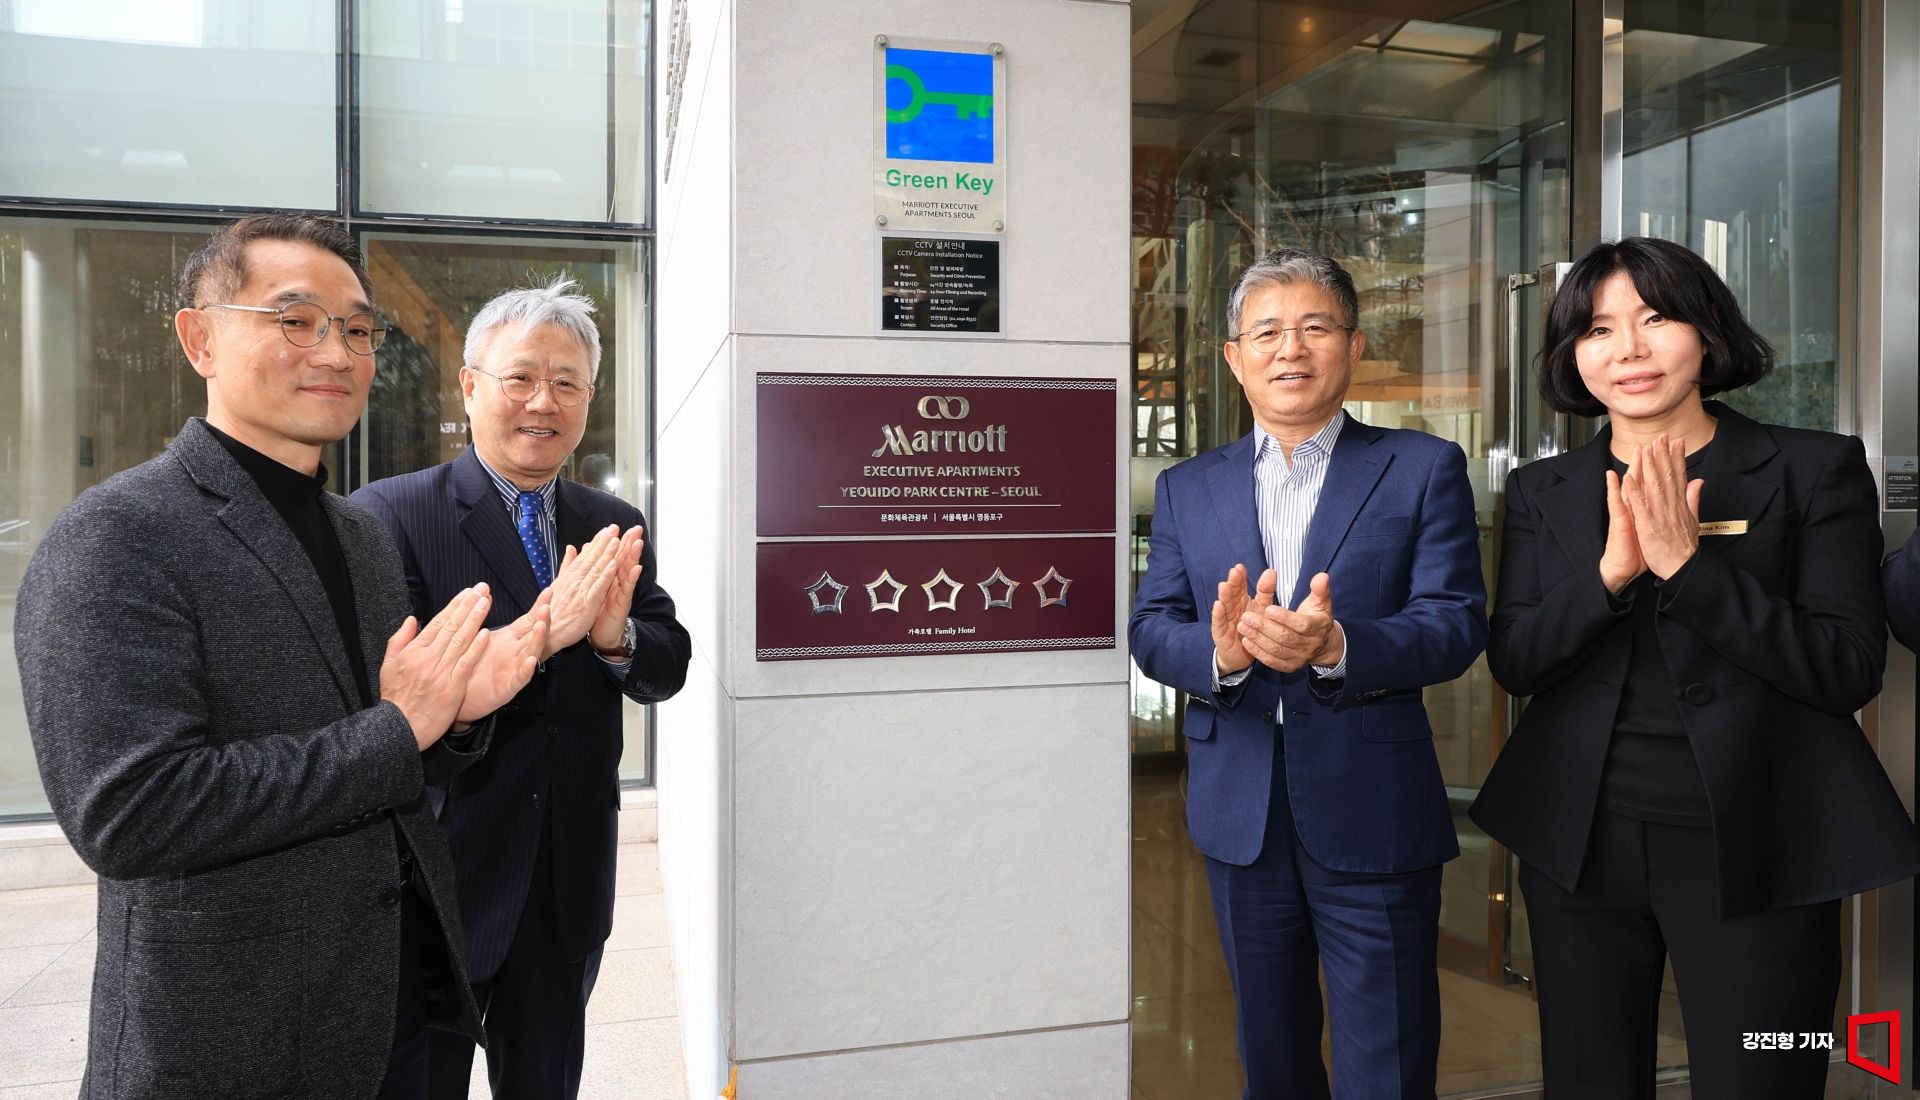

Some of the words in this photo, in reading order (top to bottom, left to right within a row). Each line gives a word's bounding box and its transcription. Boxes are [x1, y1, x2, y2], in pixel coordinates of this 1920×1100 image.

[886, 169, 948, 188] Green
[956, 173, 994, 196] Key
[905, 210, 951, 218] APARTMENTS
[872, 424, 1008, 457] Marriott
[864, 466, 934, 477] EXECUTIVE
[937, 466, 1020, 477] APARTMENTS
[840, 487, 901, 497] YEOUIDO
[904, 487, 937, 497] PARK
[940, 487, 989, 497] CENTRE
[1001, 487, 1042, 497] SEOUL
[881, 513, 928, 522] 문화체육관광부
[942, 513, 975, 521] 서울특별시
[977, 513, 1003, 521] 영등포구
